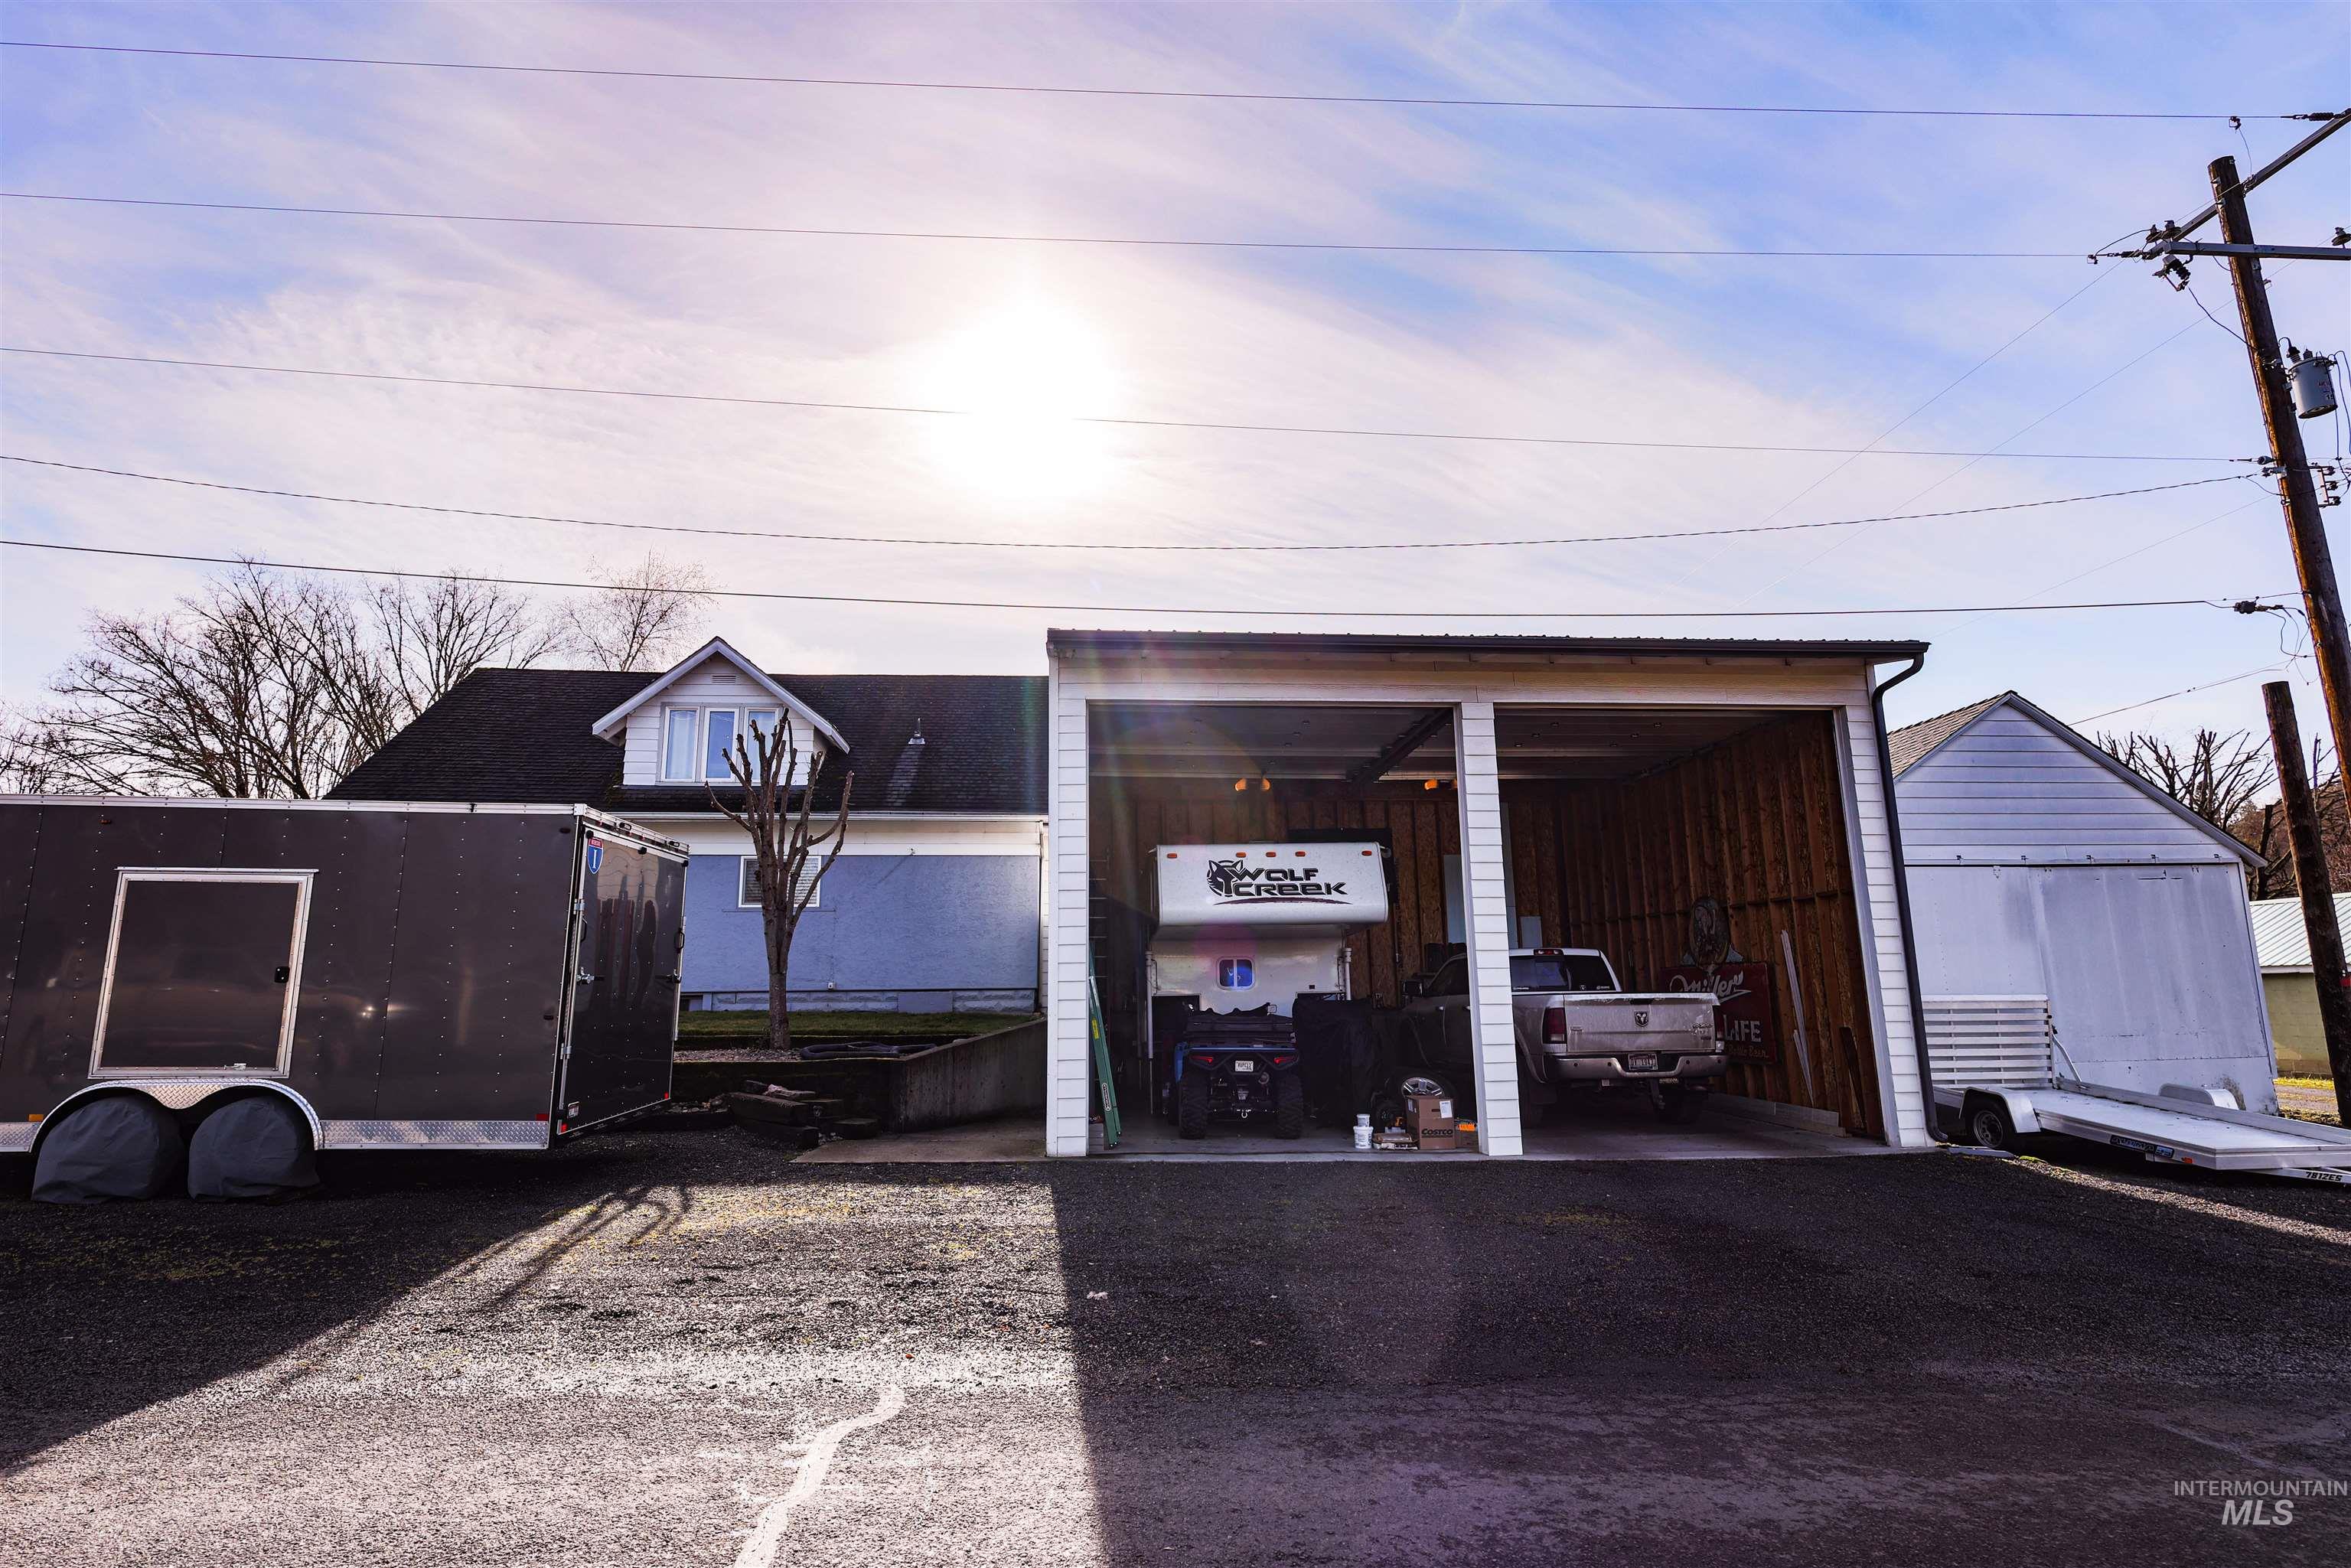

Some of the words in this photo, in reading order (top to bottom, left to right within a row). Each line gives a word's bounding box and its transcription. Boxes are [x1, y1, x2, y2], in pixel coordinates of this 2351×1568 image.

[1227, 867, 1319, 882] WOLF
[1233, 882, 1348, 896] CREEK
[1723, 1015, 1762, 1042] LIFE
